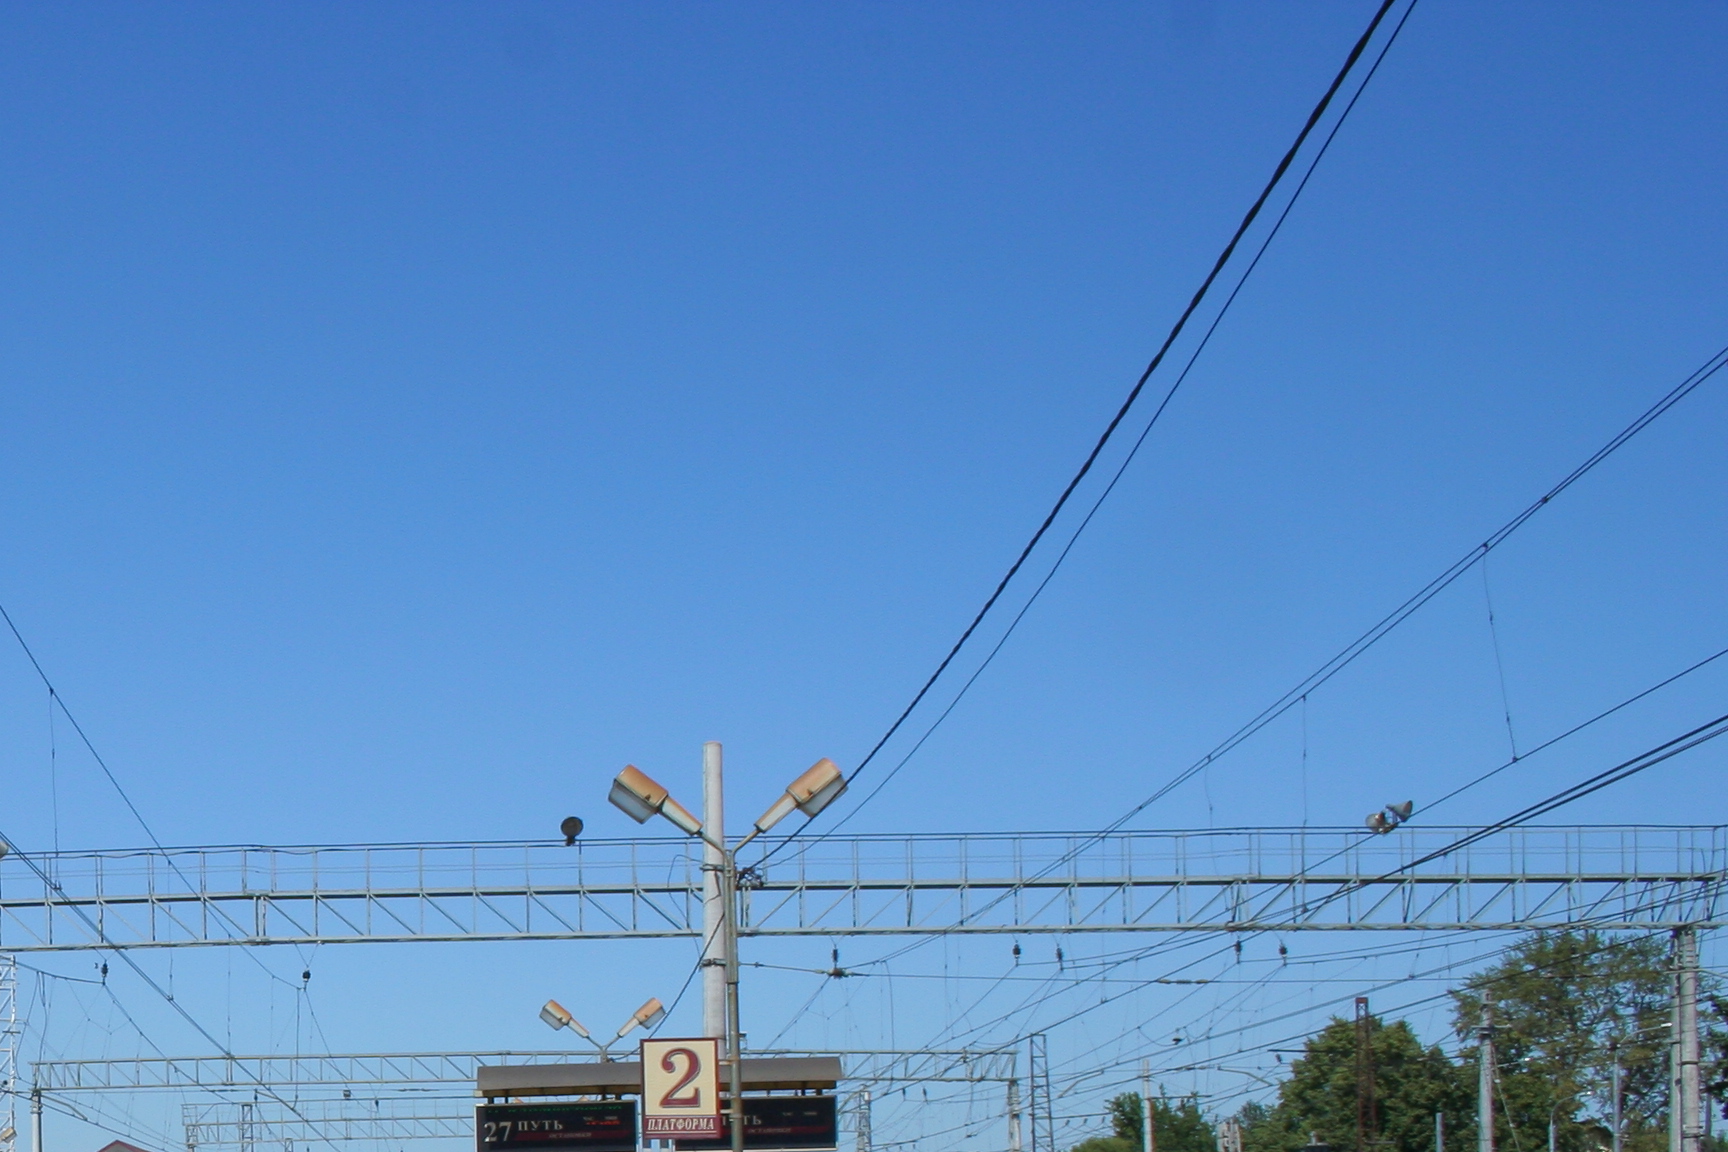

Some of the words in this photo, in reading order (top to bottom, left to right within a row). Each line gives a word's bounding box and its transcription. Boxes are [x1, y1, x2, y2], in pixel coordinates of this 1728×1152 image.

[659, 1047, 701, 1109] 2
[484, 1121, 513, 1143] 27
[518, 1120, 564, 1131] ПУТЬ
[647, 1118, 714, 1131] ПЛАТФОРМА
